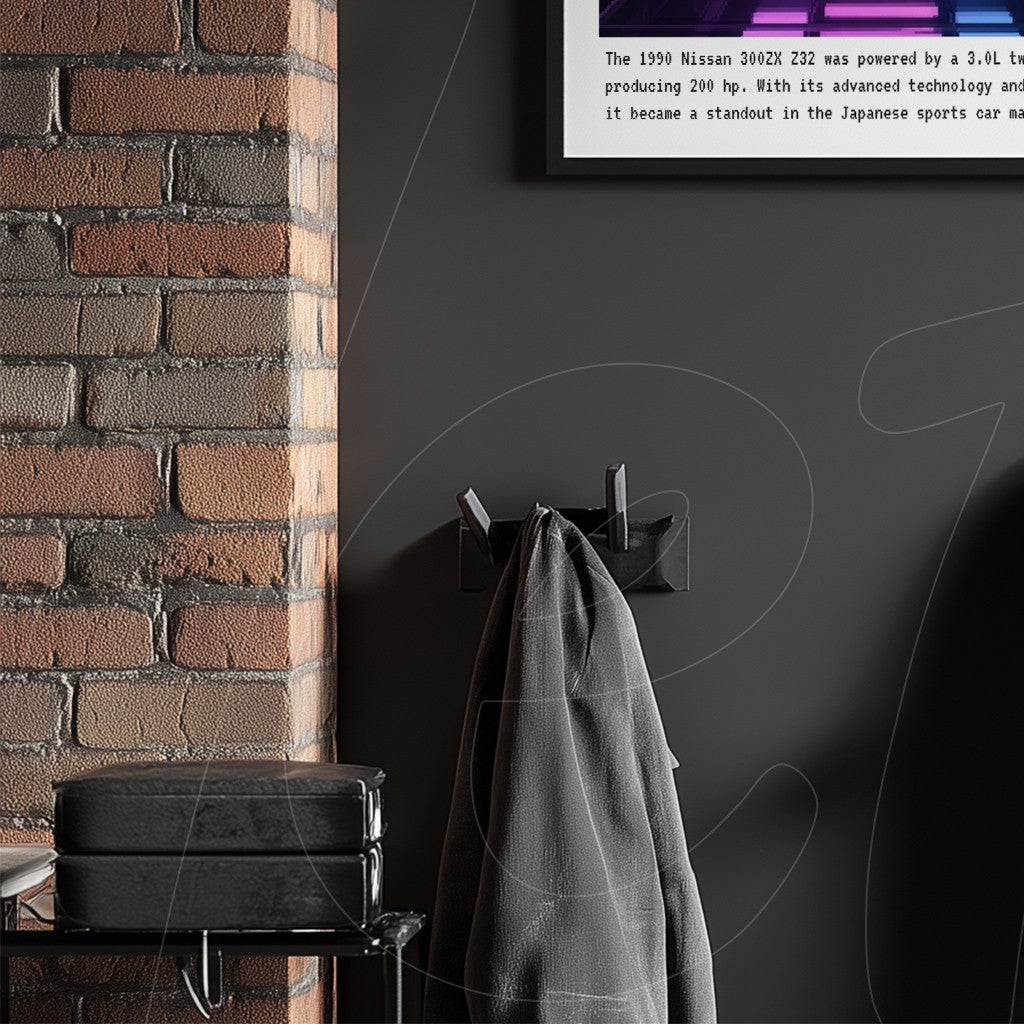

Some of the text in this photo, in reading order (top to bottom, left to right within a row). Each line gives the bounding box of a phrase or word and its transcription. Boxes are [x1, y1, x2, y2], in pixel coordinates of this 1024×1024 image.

[605, 51, 631, 66] The
[640, 51, 672, 66] 1990
[681, 51, 732, 66] Nissan
[740, 51, 782, 66] 300ZX
[791, 51, 815, 66] Z32
[824, 55, 849, 66] was
[857, 50, 917, 69] powered
[924, 50, 942, 69] by
[950, 54, 959, 65] a
[967, 50, 1001, 65] 3.0L
[605, 78, 681, 97] producing
[690, 78, 714, 93] 200
[723, 78, 746, 97] hp.
[756, 78, 791, 93] With
[800, 78, 823, 93] its
[832, 78, 900, 93] advanced
[908, 78, 993, 96] technology
[606, 106, 621, 120] it
[630, 106, 681, 120] became
[689, 109, 698, 120] a
[706, 106, 773, 120] standout
[783, 106, 799, 120] in
[807, 106, 833, 120] the
[841, 106, 909, 124] Japanese
[917, 105, 967, 124] sports
[975, 108, 1001, 120] car
